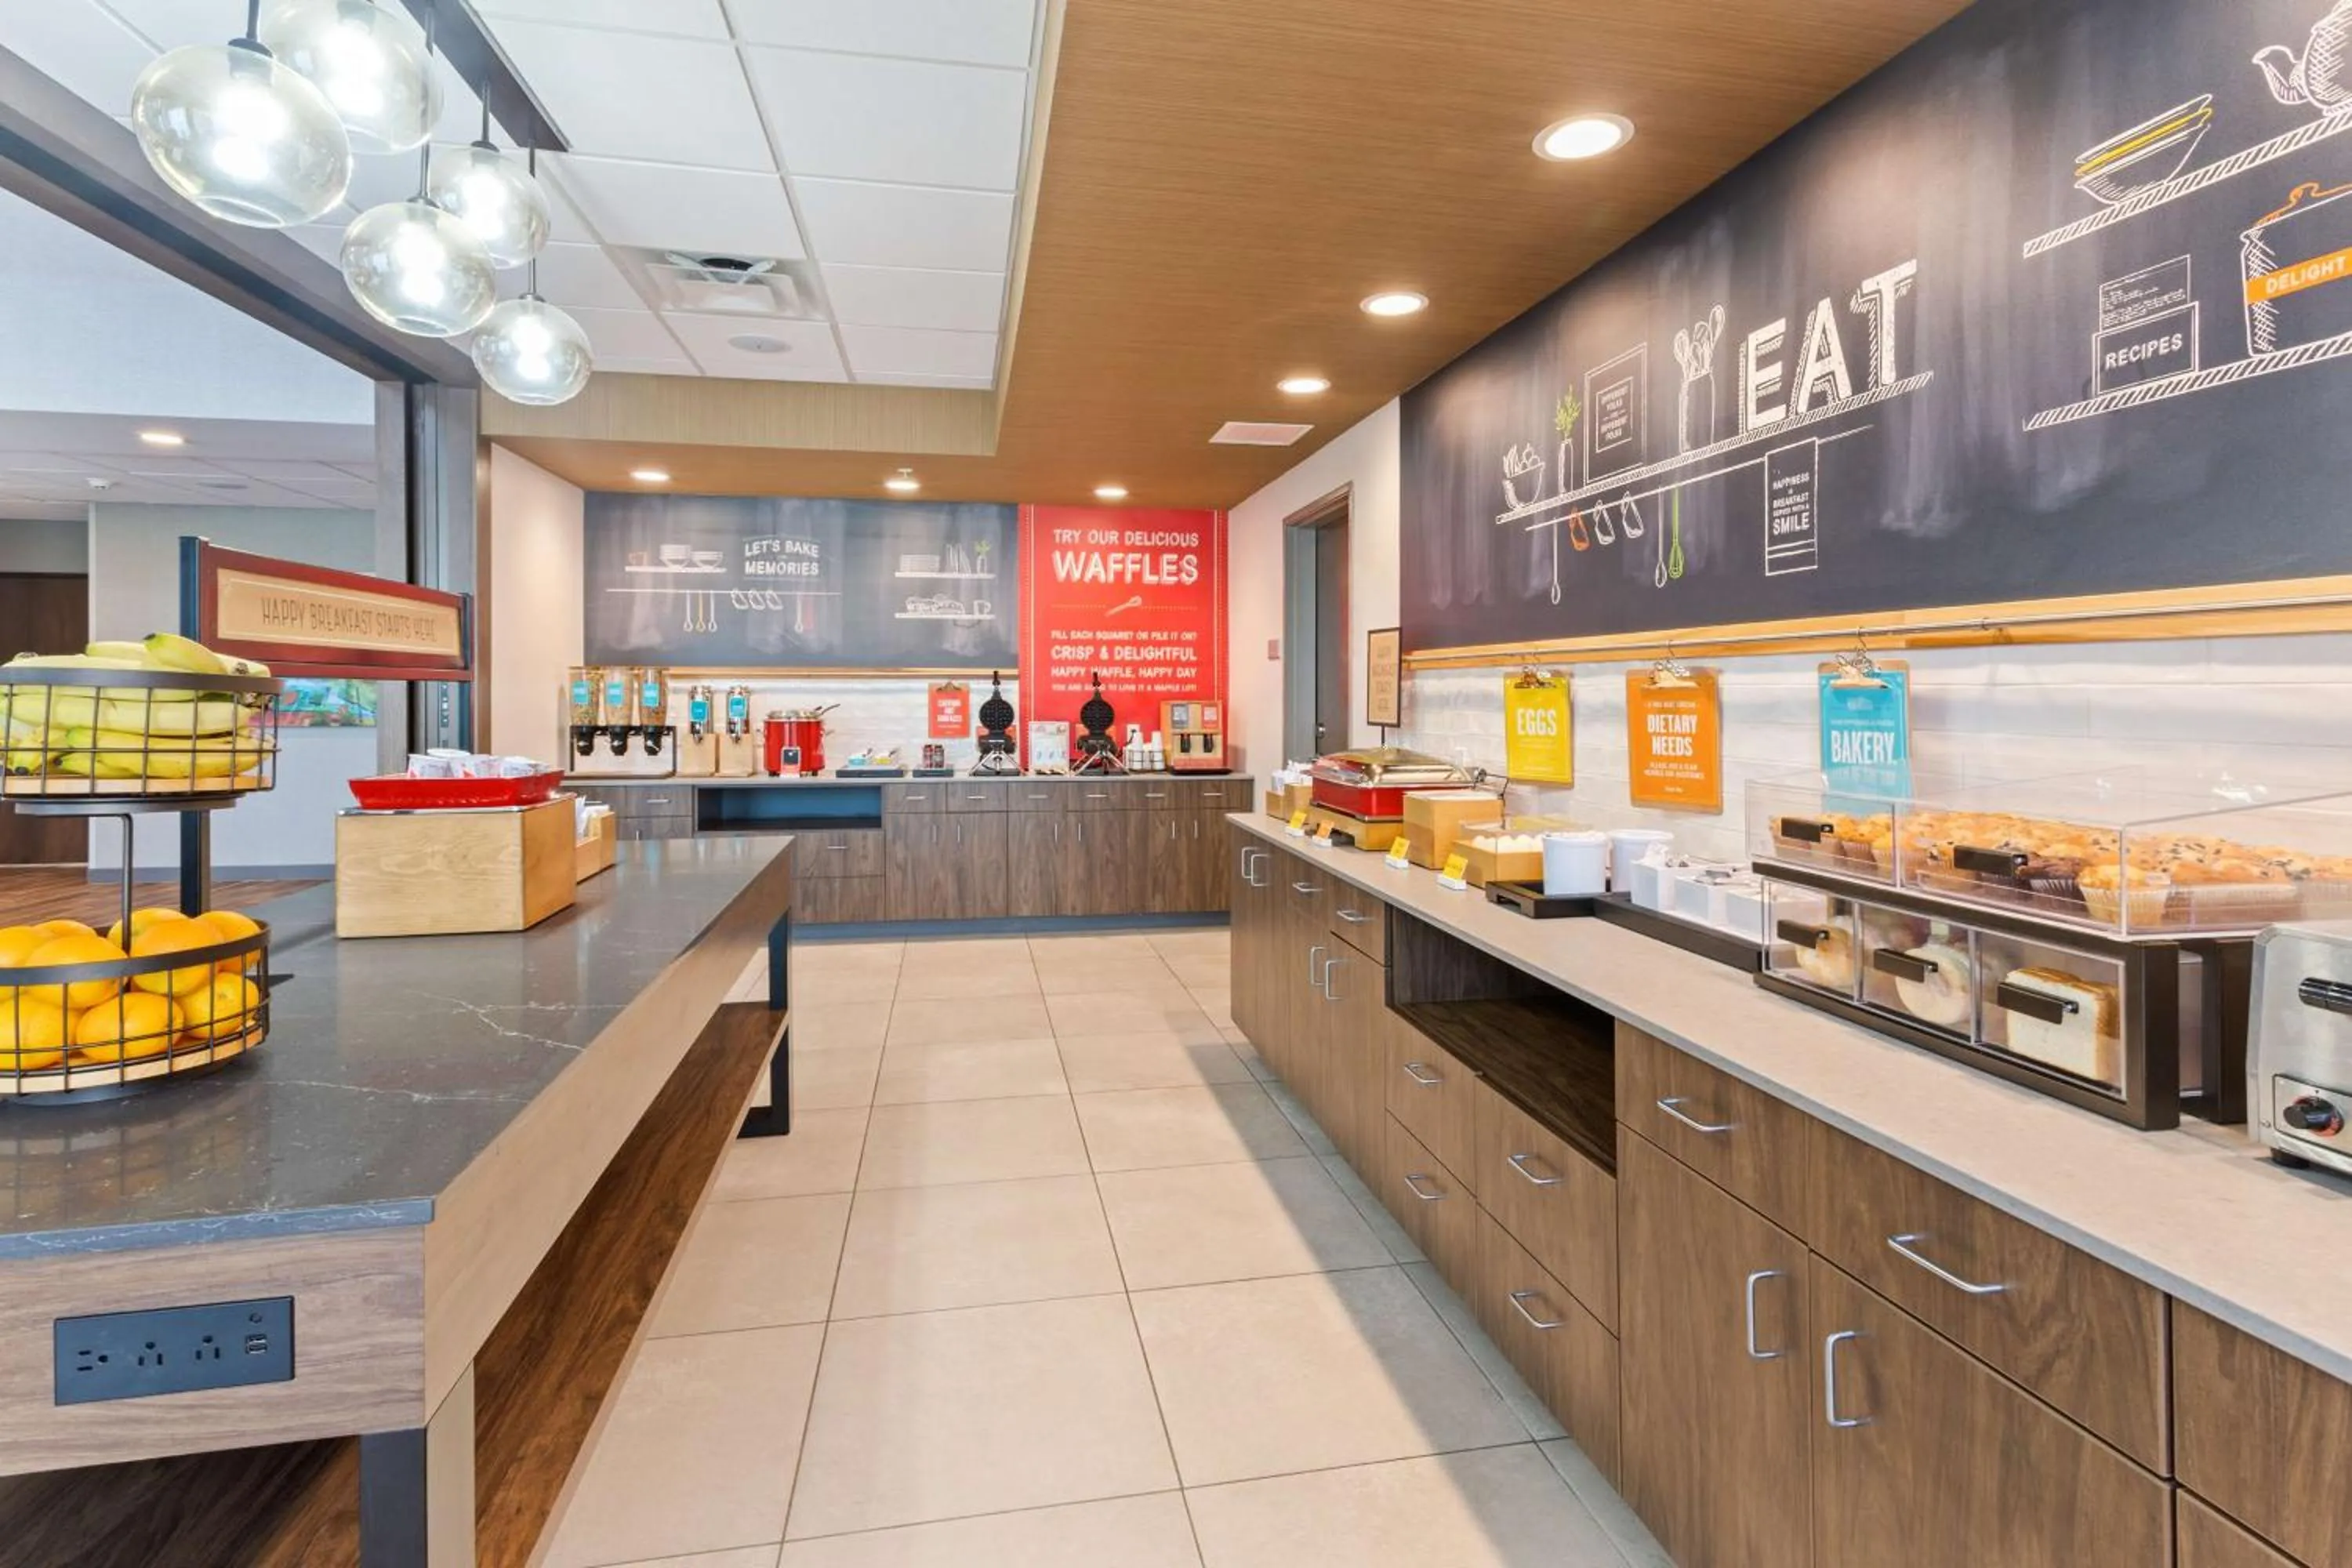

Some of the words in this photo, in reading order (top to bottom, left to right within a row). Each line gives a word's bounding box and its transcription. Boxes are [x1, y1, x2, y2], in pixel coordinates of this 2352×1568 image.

[2266, 256, 2347, 294] DELIGHT
[1739, 259, 1918, 435] EAT
[2105, 333, 2183, 370] RECIPES
[1773, 492, 1809, 508] BREAKFAST
[1773, 511, 1809, 535] SMILE
[745, 539, 780, 557] LET'S
[785, 541, 818, 557] BAKE
[1054, 529, 1082, 544] TRY
[1088, 530, 1119, 546] OUR
[1125, 532, 1199, 547] DELICIOUS
[745, 561, 818, 575] MEMORIES
[1053, 550, 1199, 585] WAFFLES
[262, 597, 304, 630] HAPPY
[310, 603, 372, 636] BREAKFAST
[376, 612, 411, 640] STARTS
[1051, 645, 1094, 659] CRISP
[1099, 645, 1109, 660] &
[1114, 646, 1197, 661] DELIGHTFUL
[1051, 666, 1086, 677] HAPPY
[1138, 667, 1174, 678] HAPPY
[1177, 667, 1197, 678] DAY
[1517, 708, 1557, 735] EGGS
[1647, 714, 1697, 734] DIETARY
[1652, 736, 1693, 757] NEEDS
